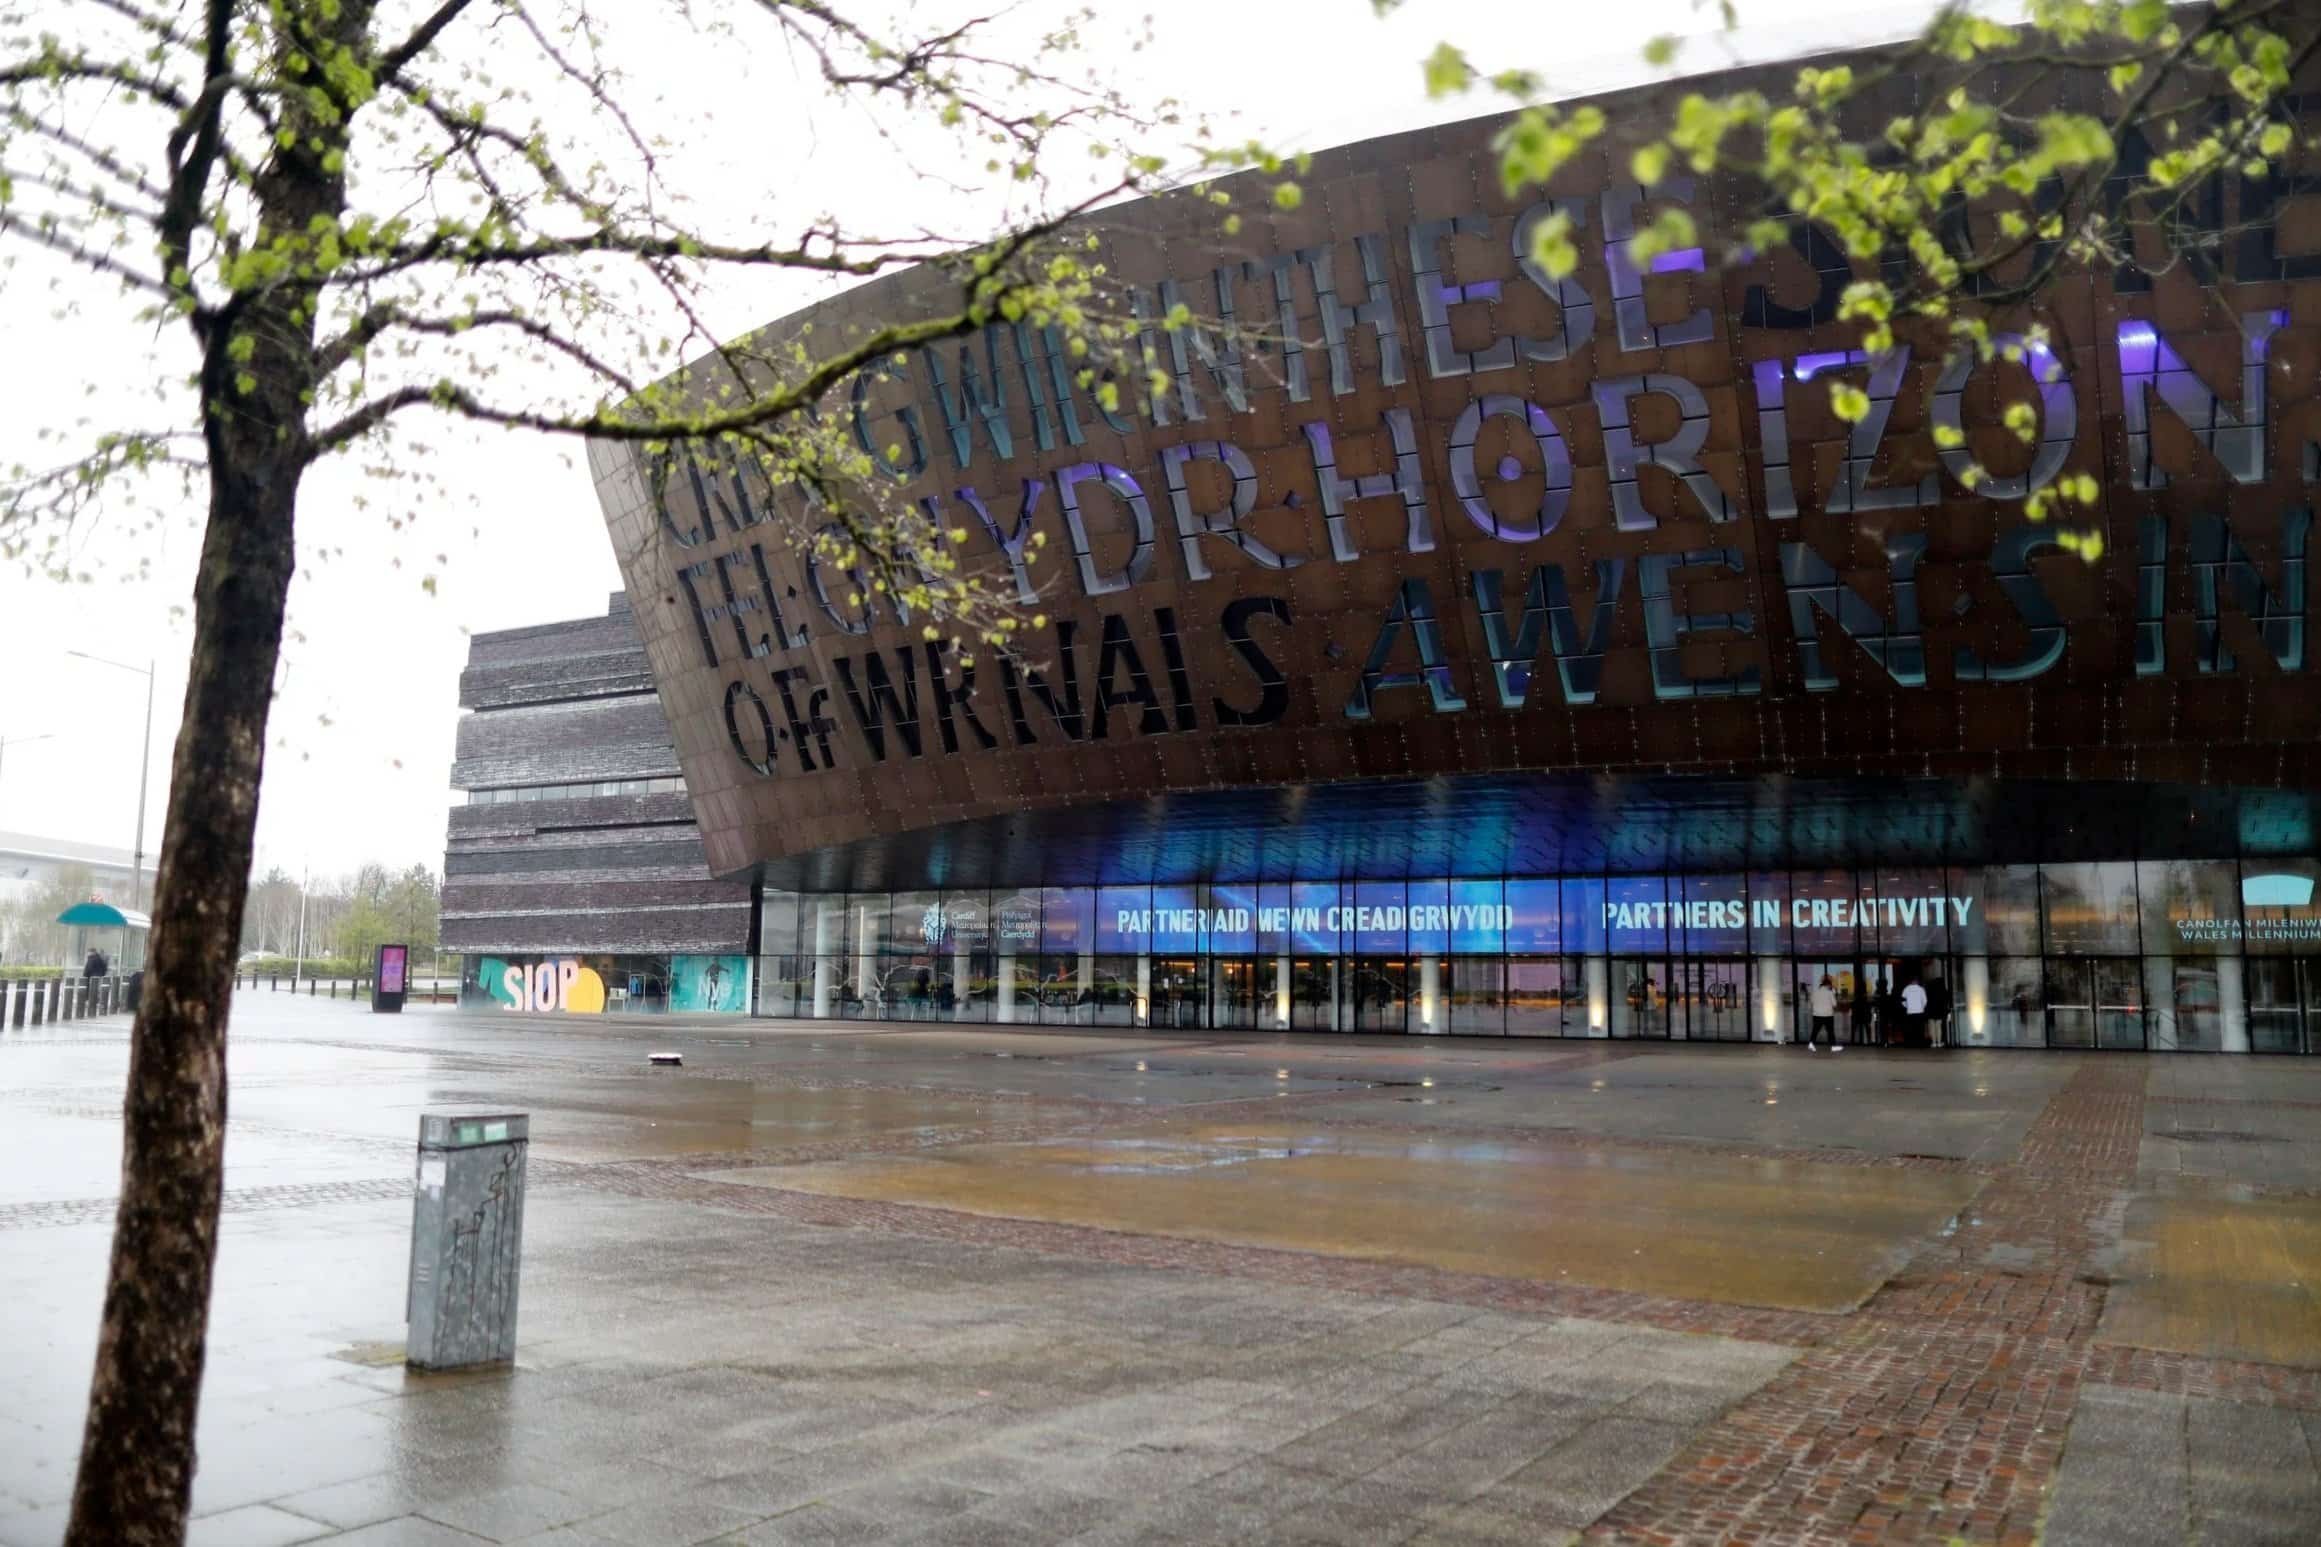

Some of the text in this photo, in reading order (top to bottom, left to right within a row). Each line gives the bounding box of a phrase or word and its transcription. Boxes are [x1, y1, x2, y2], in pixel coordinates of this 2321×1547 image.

[1242, 174, 1717, 403] THESE
[1302, 310, 2321, 563] HORIZON
[1345, 533, 1930, 720] AWEN
[951, 920, 996, 930] Metropolitn
[1117, 904, 1513, 933] PARTNERIAID MEWN CREADIGRWYDD
[1602, 896, 1973, 929] PARTNERS IN CREATIVITY
[2256, 918, 2321, 928] MILENIW
[2181, 929, 2227, 940] WALES
[503, 960, 579, 1012] SIOP
